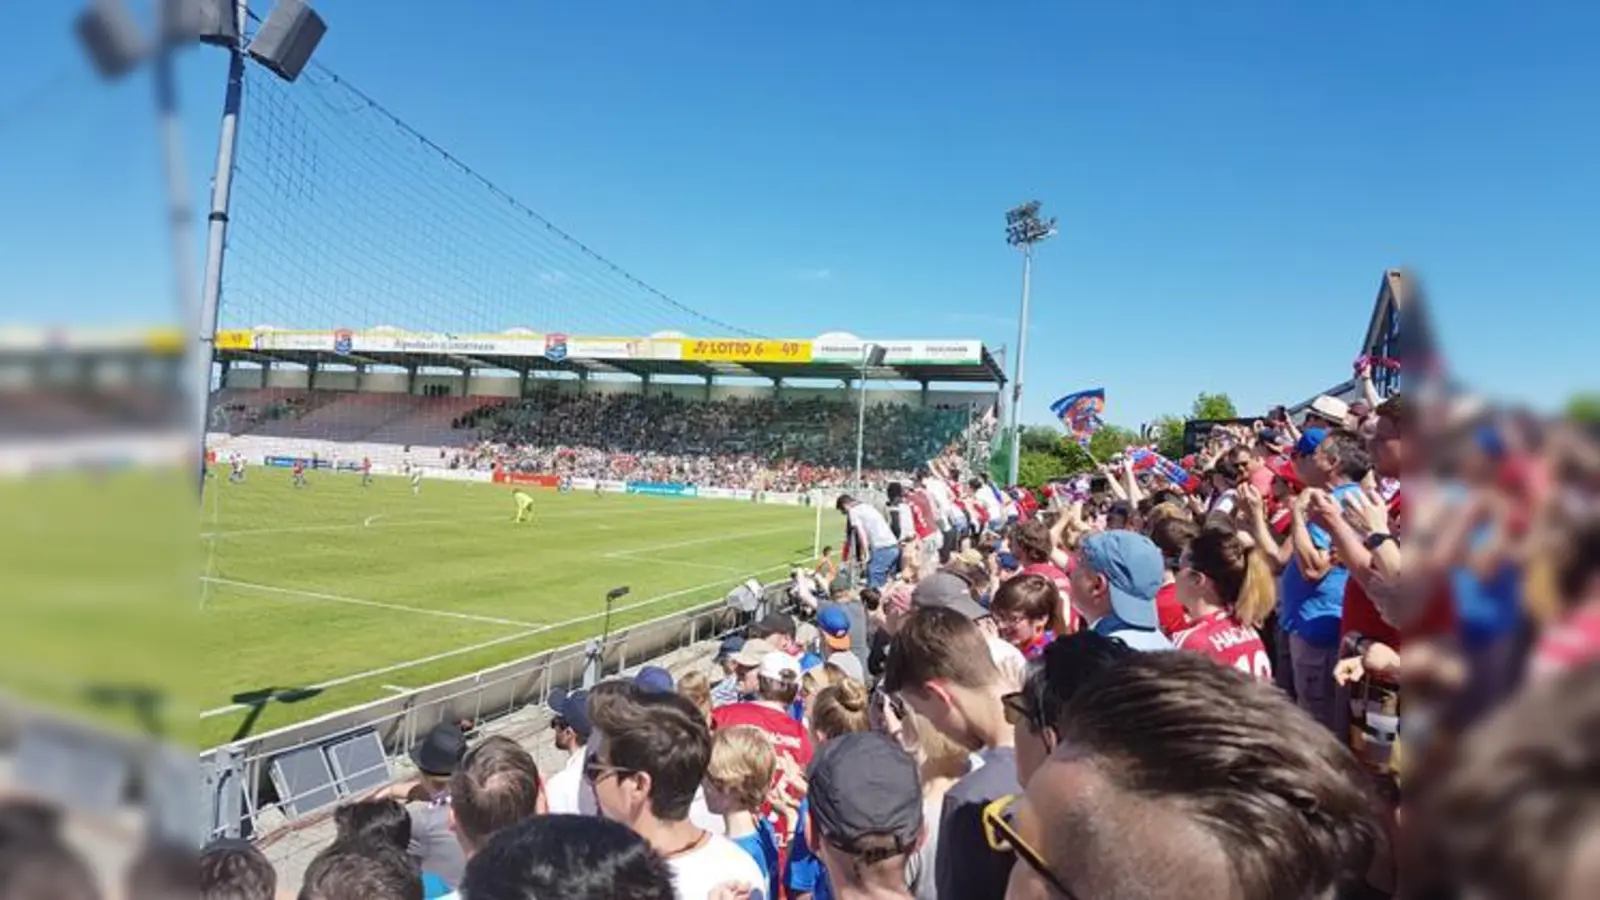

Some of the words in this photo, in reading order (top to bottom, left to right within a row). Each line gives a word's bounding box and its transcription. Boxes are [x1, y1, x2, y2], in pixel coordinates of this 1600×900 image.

[709, 341, 752, 356] LOTTO
[753, 342, 765, 356] 6
[781, 342, 800, 357] 49
